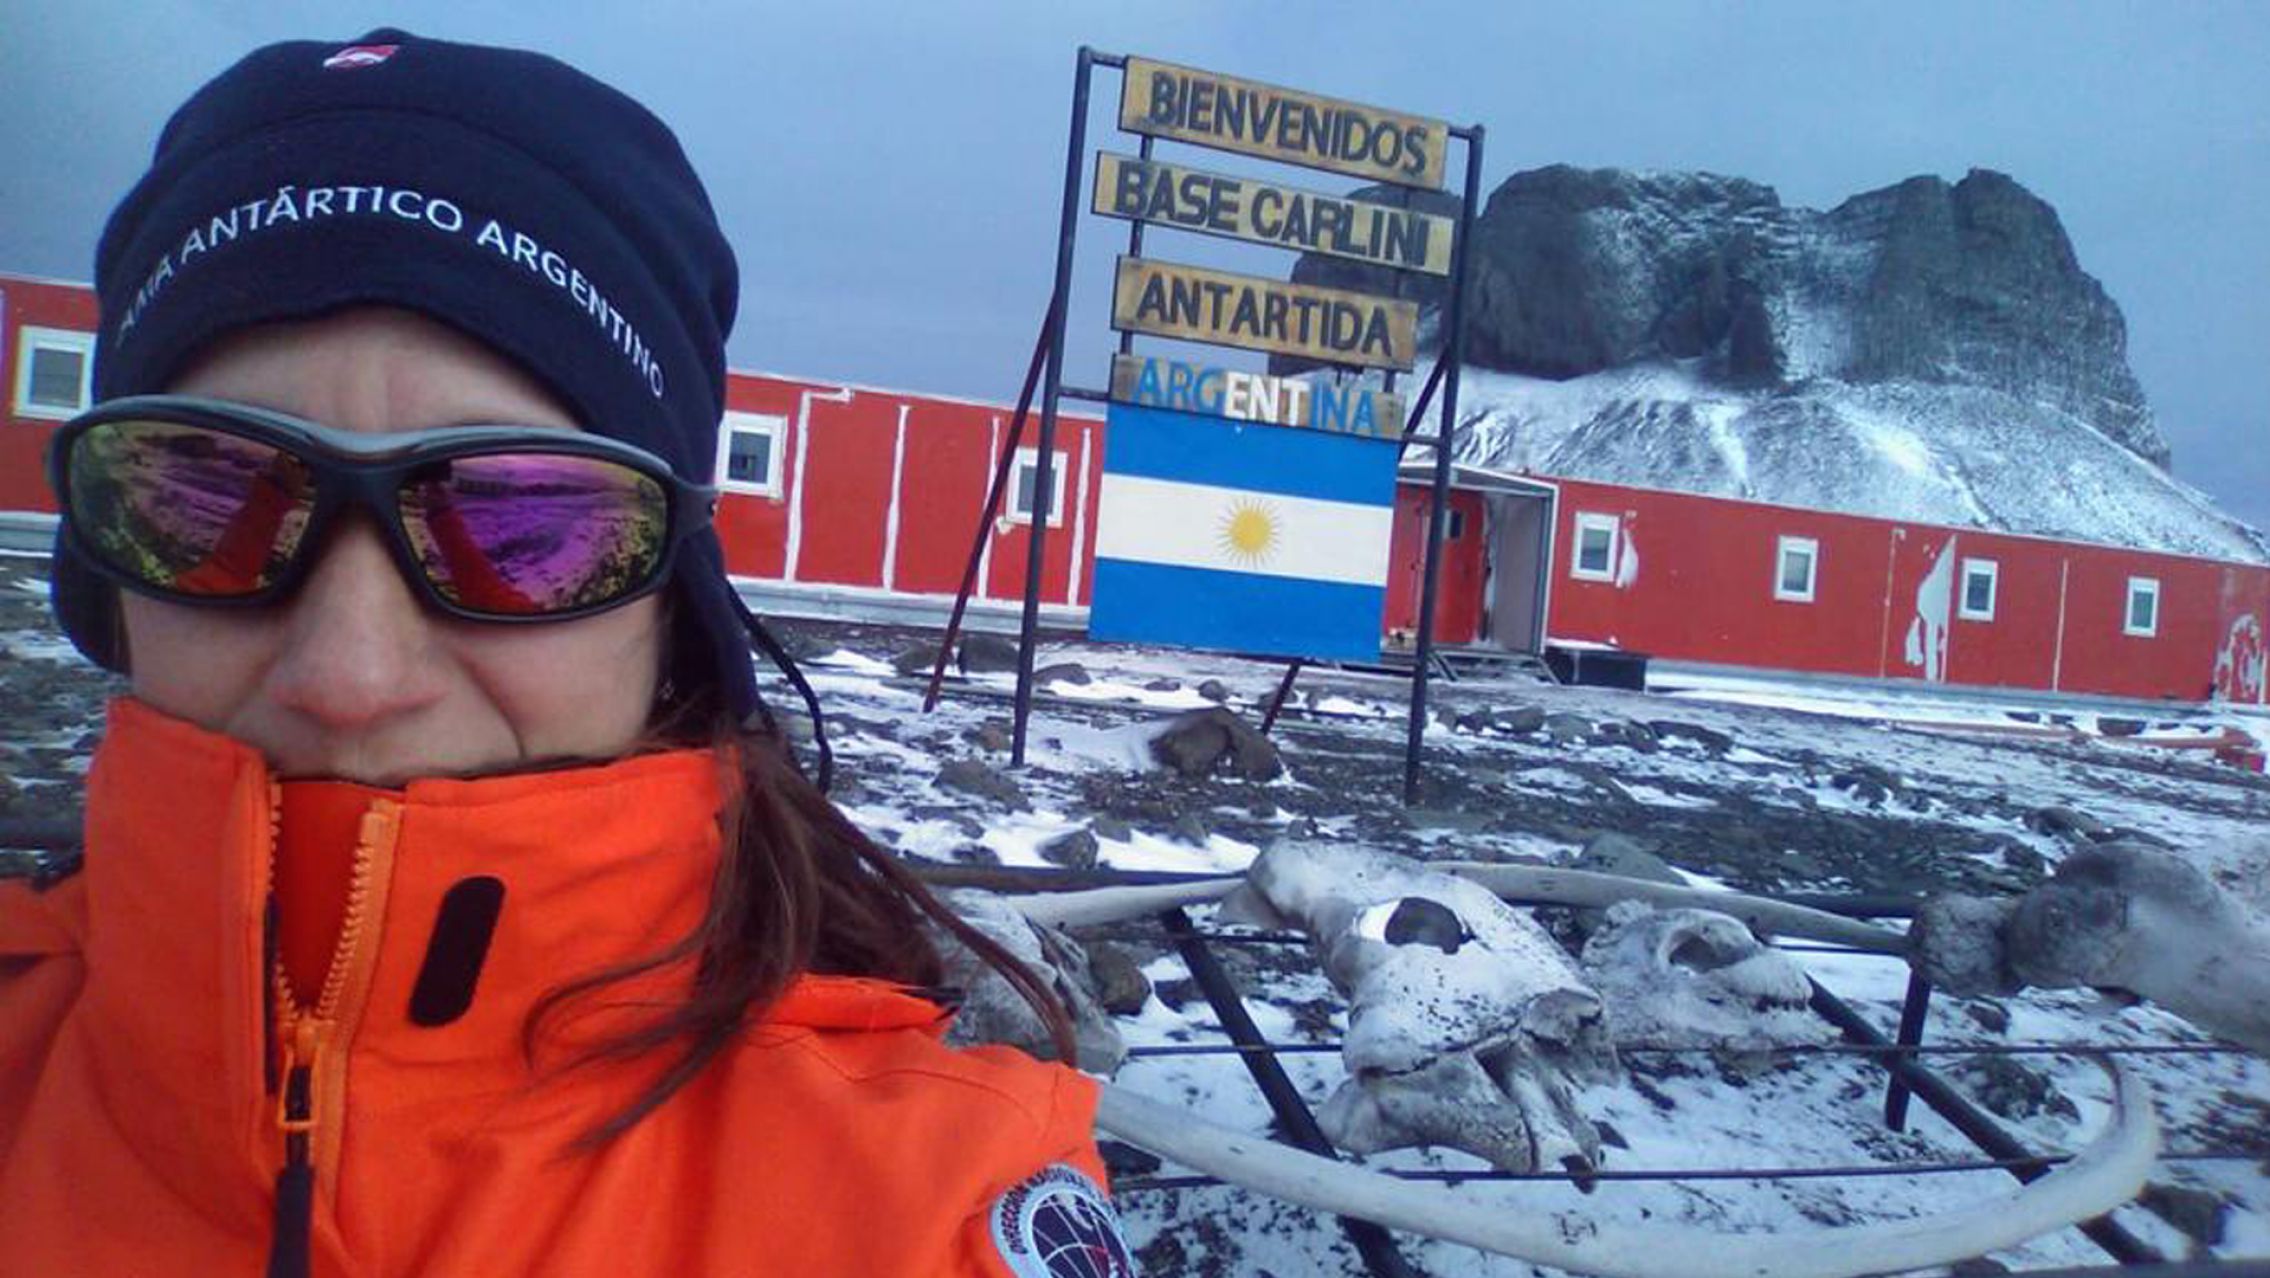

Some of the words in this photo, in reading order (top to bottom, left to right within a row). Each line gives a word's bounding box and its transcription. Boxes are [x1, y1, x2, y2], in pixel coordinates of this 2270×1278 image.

[1149, 70, 1428, 175] BIENVENIDOS
[1114, 159, 1241, 233] BASE
[1251, 189, 1430, 266] CARLINI
[180, 185, 463, 263] ANTÁRTICO
[476, 220, 665, 399] ARGENTINO
[1135, 272, 1392, 356] ANTARTIDA
[1134, 358, 1379, 434] ARGENTINA
